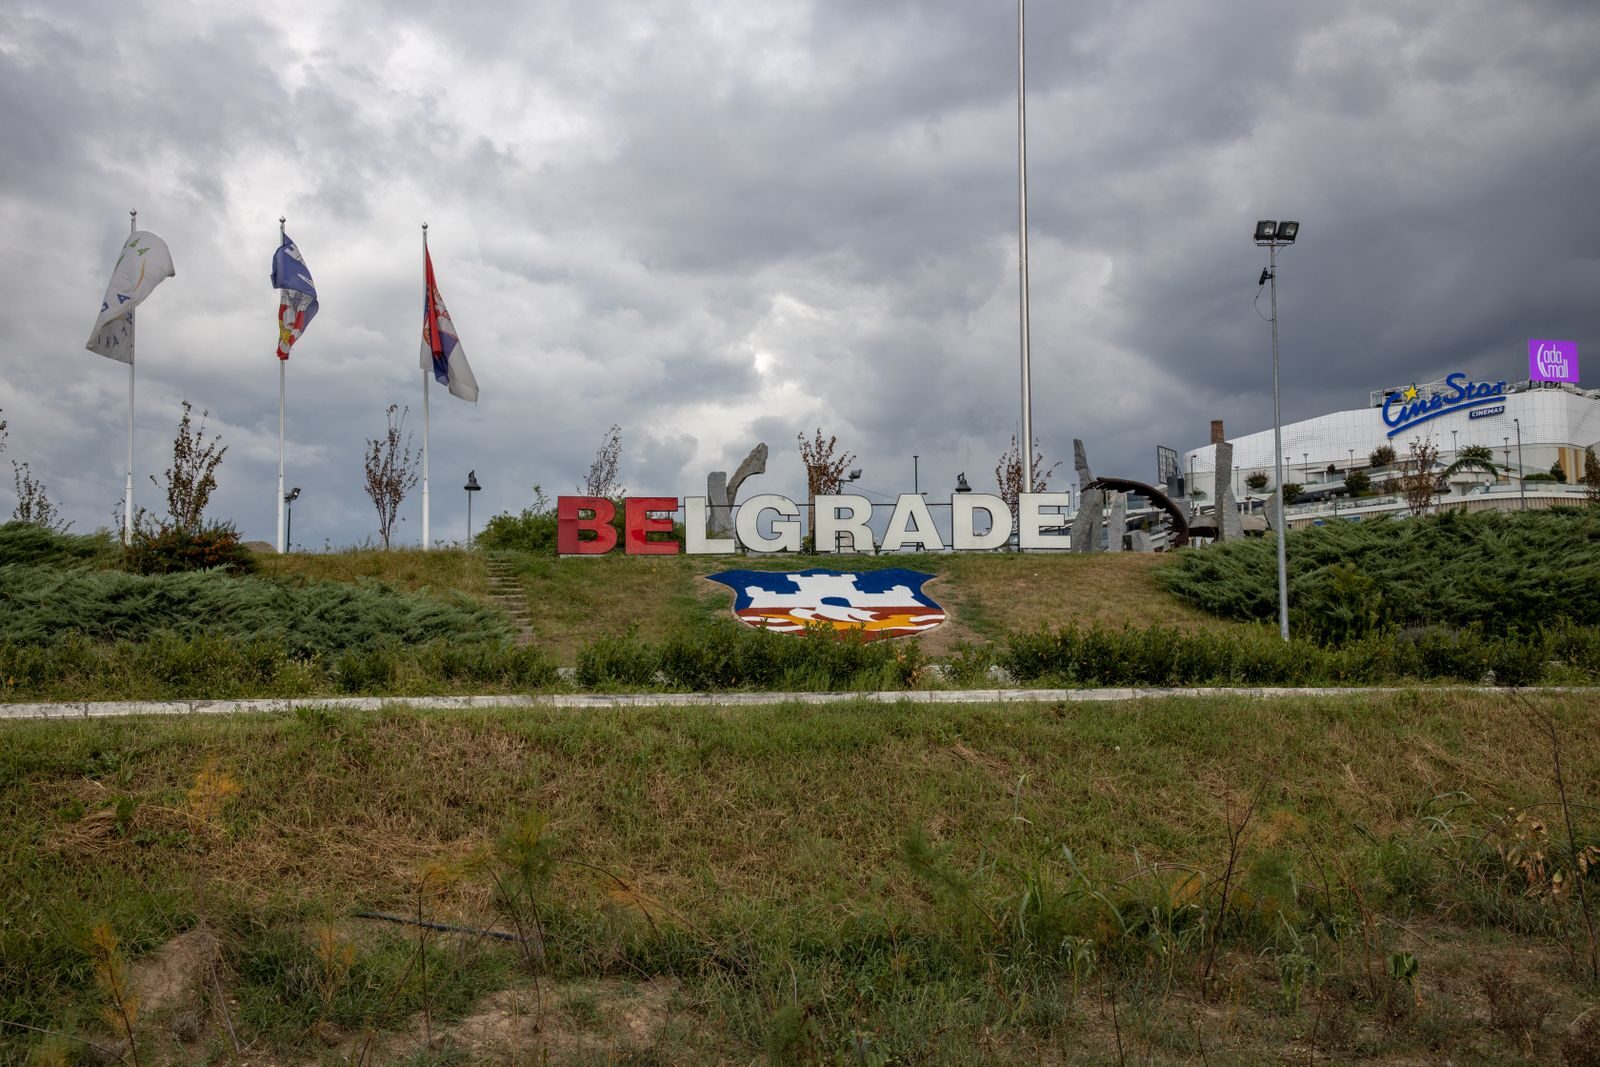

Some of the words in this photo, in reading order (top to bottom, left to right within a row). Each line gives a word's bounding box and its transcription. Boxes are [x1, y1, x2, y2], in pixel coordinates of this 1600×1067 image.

[1543, 344, 1562, 363] ada
[1548, 359, 1568, 378] mall
[1382, 372, 1506, 427] CineStar
[1471, 406, 1503, 417] CINEMAS
[557, 493, 1072, 555] BELGRADE
